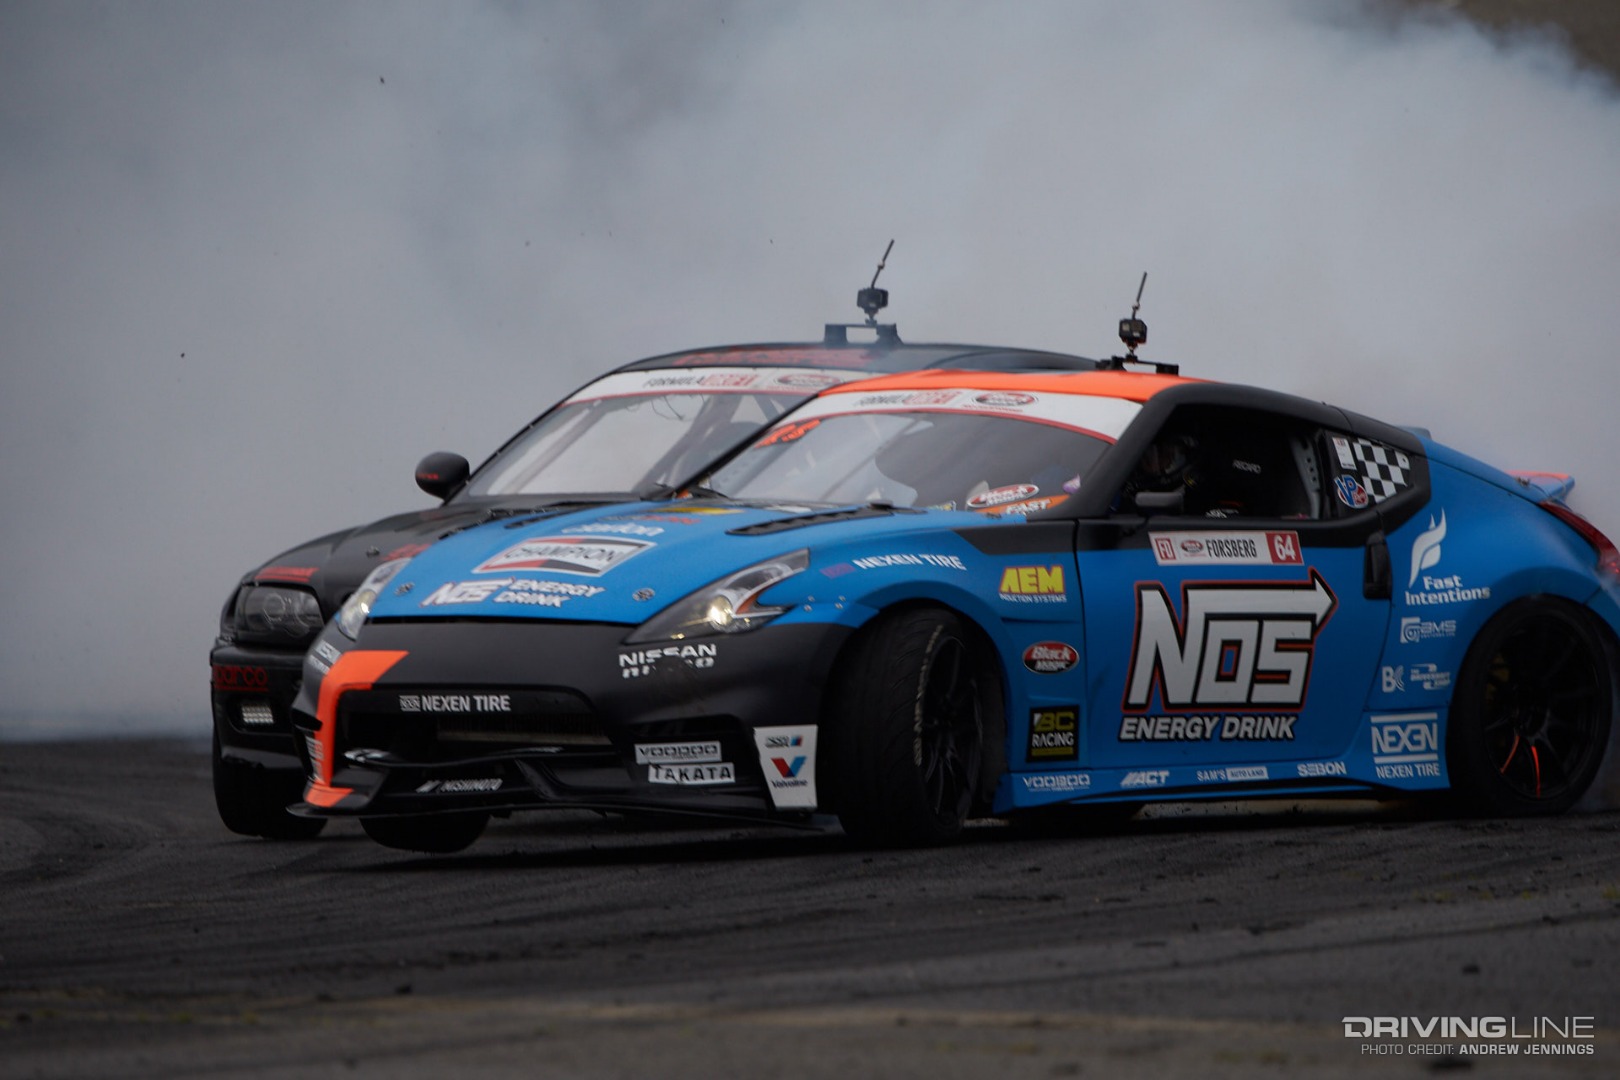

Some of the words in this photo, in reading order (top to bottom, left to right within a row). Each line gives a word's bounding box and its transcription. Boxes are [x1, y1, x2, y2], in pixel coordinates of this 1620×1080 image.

[1206, 539, 1257, 558] FORSBERG
[1274, 534, 1297, 561] 64
[852, 554, 923, 569] NEXEN
[918, 553, 967, 570] TIRE
[508, 579, 606, 597] ENERGY
[1000, 565, 1065, 593] AEM
[1423, 575, 1463, 591] Fast
[493, 591, 571, 607] DRINK
[1405, 586, 1491, 606] Intentions
[1124, 574, 1335, 709] NOS
[619, 643, 717, 667] NISSAN
[421, 694, 471, 712] NEXEN
[473, 694, 511, 711] TIRE
[1033, 711, 1075, 732] BC
[1119, 716, 1219, 740] ENERGY
[1220, 716, 1297, 740] DRINK
[1031, 732, 1075, 747] RACING
[1371, 722, 1438, 754] NEXEN
[639, 745, 718, 756] VOODOO
[649, 764, 731, 781] TAKATA
[1196, 770, 1226, 781] SAM'S
[1376, 764, 1414, 779] NEXEN
[1415, 762, 1440, 777] TIRE
[1022, 774, 1091, 788] VOODOO
